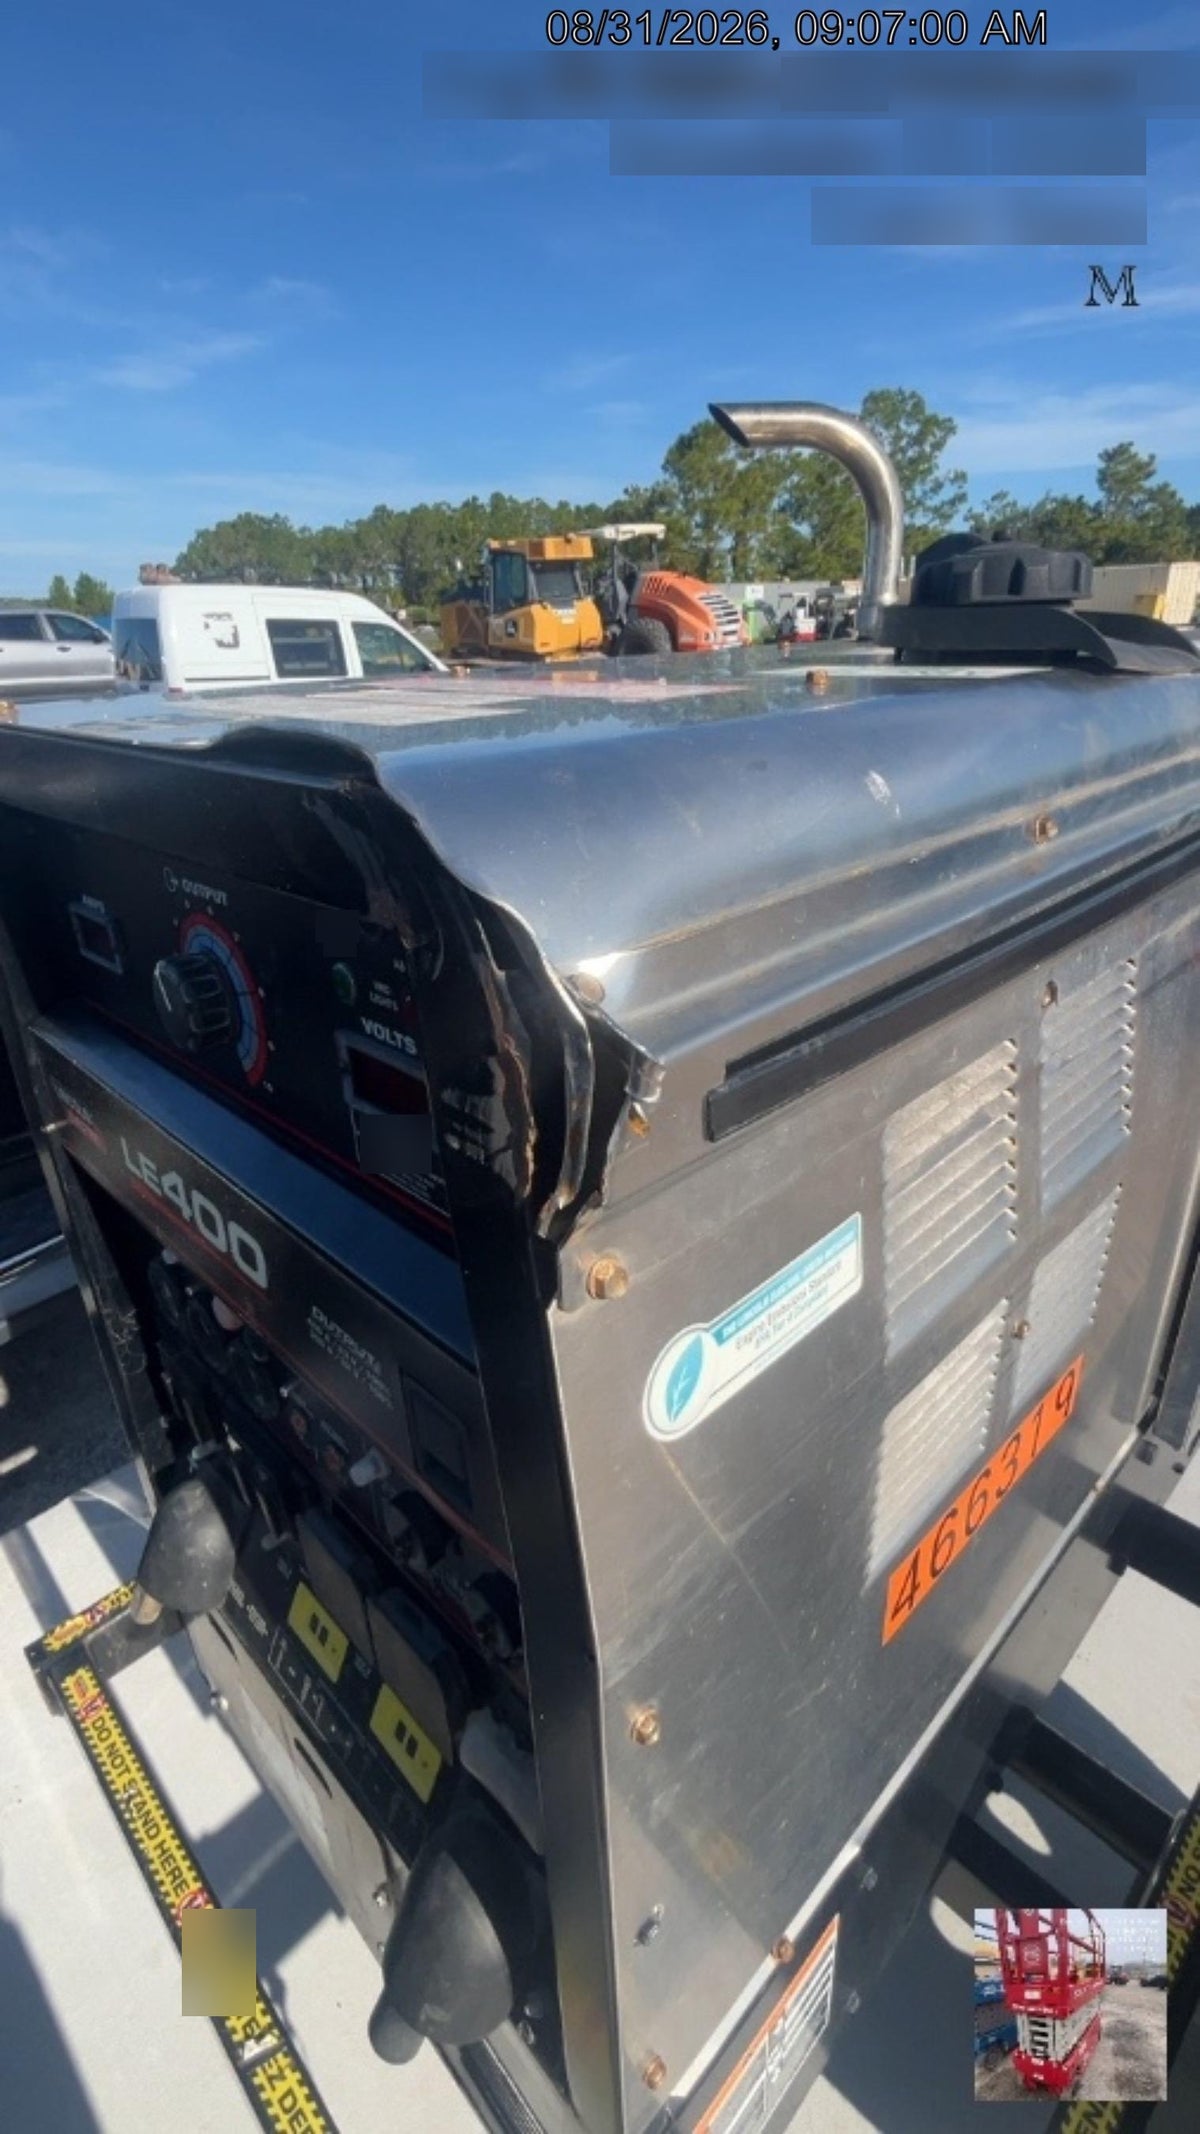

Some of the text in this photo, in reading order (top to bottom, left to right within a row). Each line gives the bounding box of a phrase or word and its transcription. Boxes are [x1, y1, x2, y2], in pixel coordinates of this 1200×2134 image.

[181, 878, 228, 907] OUTPUT
[361, 1016, 418, 1056] VOLTS
[120, 1136, 268, 1289] LE400
[891, 1368, 1076, 1621] 466319
[91, 1715, 190, 1897] DO NOT STAND HERE
